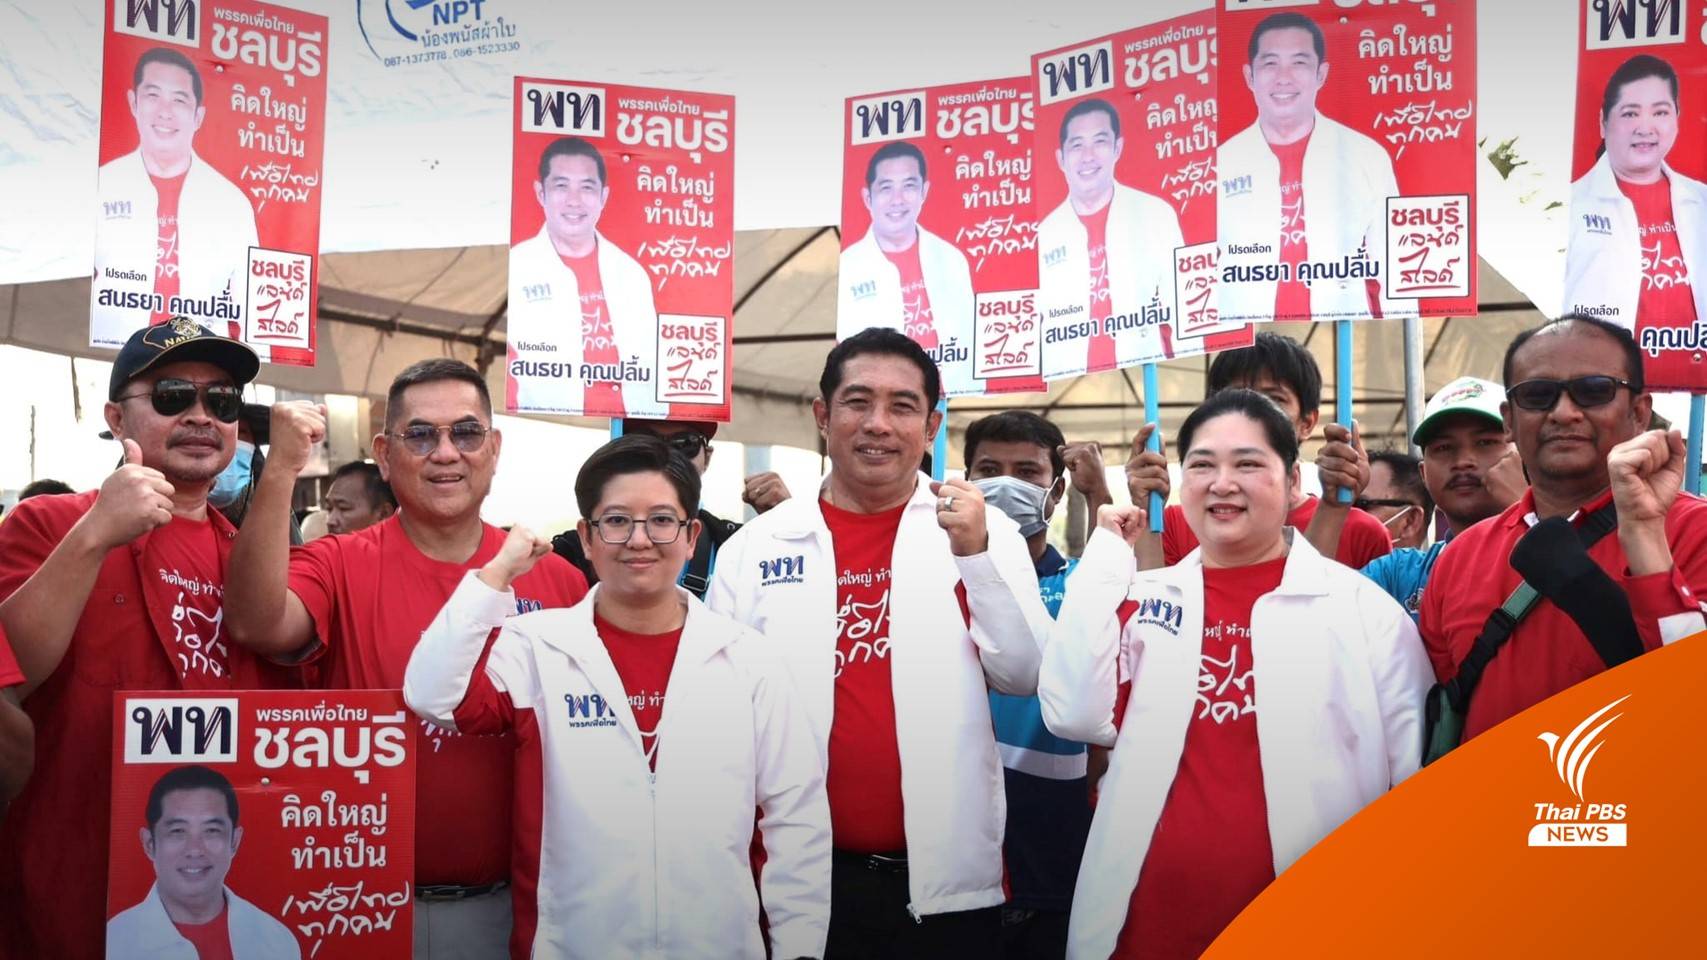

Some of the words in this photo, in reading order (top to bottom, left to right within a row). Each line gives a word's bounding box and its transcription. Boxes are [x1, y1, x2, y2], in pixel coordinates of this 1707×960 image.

[213, 6, 295, 34] พรรคเพื่อไทย
[432, 0, 486, 26] NPT
[1593, 0, 1680, 41] พท
[211, 22, 322, 87] ชลบุรี
[1124, 24, 1204, 54] พรรคเพื่อไทย
[1358, 23, 1452, 62] คิดใหญ่
[1043, 48, 1110, 97] พท
[1368, 58, 1452, 95] ทำเป็น
[231, 84, 307, 131] คิดใหญ่
[527, 88, 601, 131] พท
[618, 95, 700, 115] พรรคเพื่อไทย
[938, 85, 1017, 106] พรรคเพื่อไทย
[856, 97, 922, 138] พท
[238, 121, 305, 157] ทำเป็น
[616, 110, 729, 164] ชลบุรี
[955, 149, 1032, 181] คิดใหญ่
[637, 165, 715, 204] คิดใหญ่
[962, 178, 1031, 209] ทำเป็น
[1171, 179, 1217, 215] ทุกค
[644, 196, 714, 228] ทำเป็น
[1391, 201, 1460, 232] ชลบุรี
[1228, 243, 1272, 255] โปรดเลือก
[105, 267, 148, 282] โปรดเลือก
[252, 259, 305, 286] ชลบุรี
[1222, 263, 1289, 283] สนธยา
[1298, 248, 1379, 286] คุณปลื้ม
[98, 288, 162, 311] สนธยา
[979, 293, 1035, 320] ชลบุรี
[1049, 304, 1084, 318] โปรดเลือก
[1574, 304, 1620, 317] โปรดเลือก
[661, 322, 718, 347] ชลบุรี
[1045, 320, 1098, 344] สนธยา
[1104, 297, 1171, 338] คุณปลื้ม
[517, 341, 557, 352] โปรดเลือก
[511, 359, 572, 378] สนธยา
[579, 355, 651, 384] คุณปลื้ม
[759, 555, 804, 579] พท
[255, 700, 368, 722] พรรคเพื่อไทย
[132, 706, 232, 755] พท
[253, 711, 406, 784] ชลบุรี
[281, 790, 388, 836] คิดใหญ่
[291, 830, 387, 870] ทำเป็น
[281, 880, 410, 917] เพื่อไทย
[297, 909, 396, 958] ทุกคน
